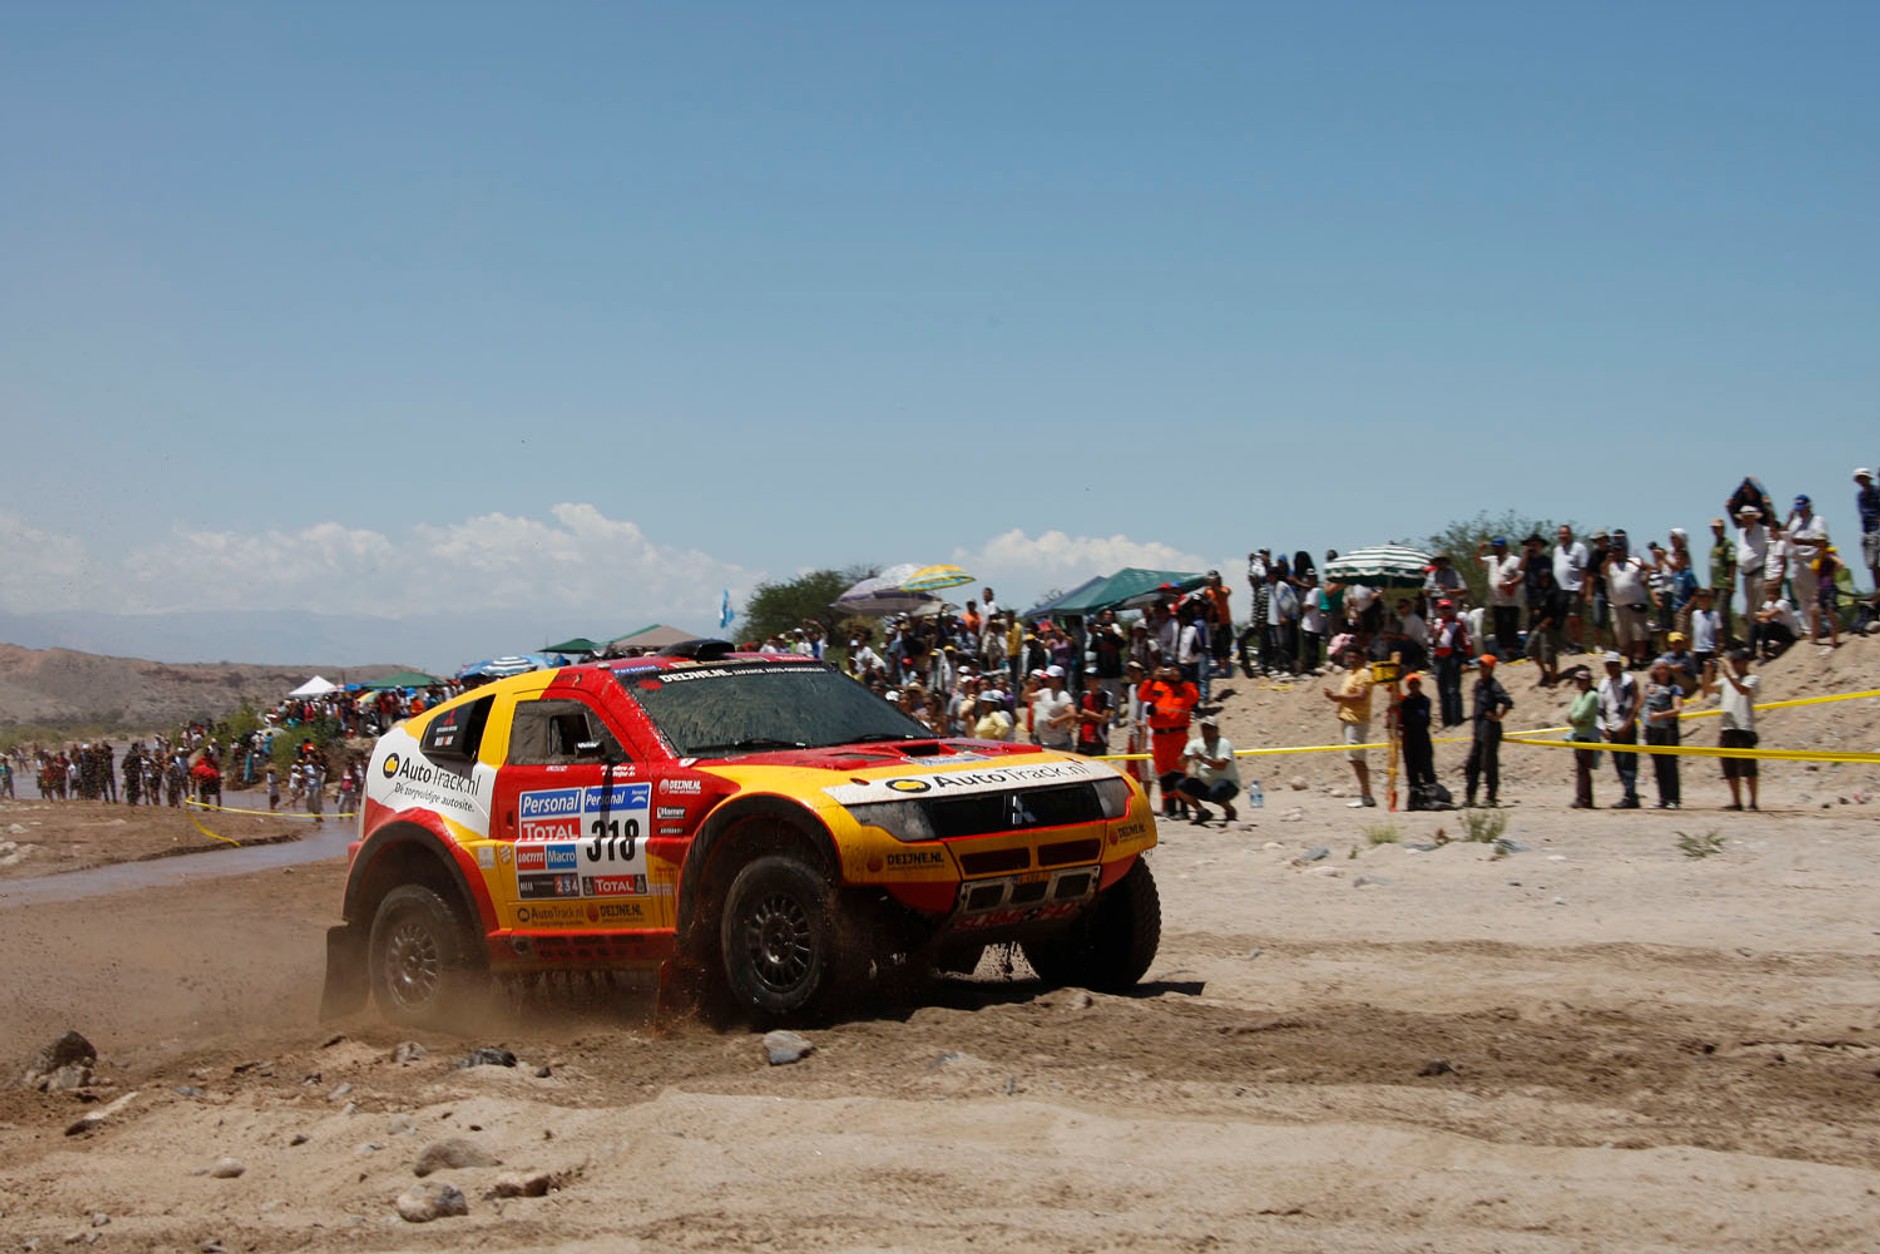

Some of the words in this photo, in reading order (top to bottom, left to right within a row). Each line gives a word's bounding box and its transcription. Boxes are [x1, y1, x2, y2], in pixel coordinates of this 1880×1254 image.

[399, 757, 481, 796] AutoTrack.nl
[933, 762, 1091, 788] AutoTrack.nl
[395, 782, 404, 794] De
[523, 791, 580, 814] Personal
[586, 791, 625, 806] Personal
[523, 823, 579, 841] TOTAL
[586, 818, 639, 862] 318
[518, 851, 545, 864] LOCTITE
[547, 849, 576, 863] Macro
[596, 878, 633, 892] TOTAL
